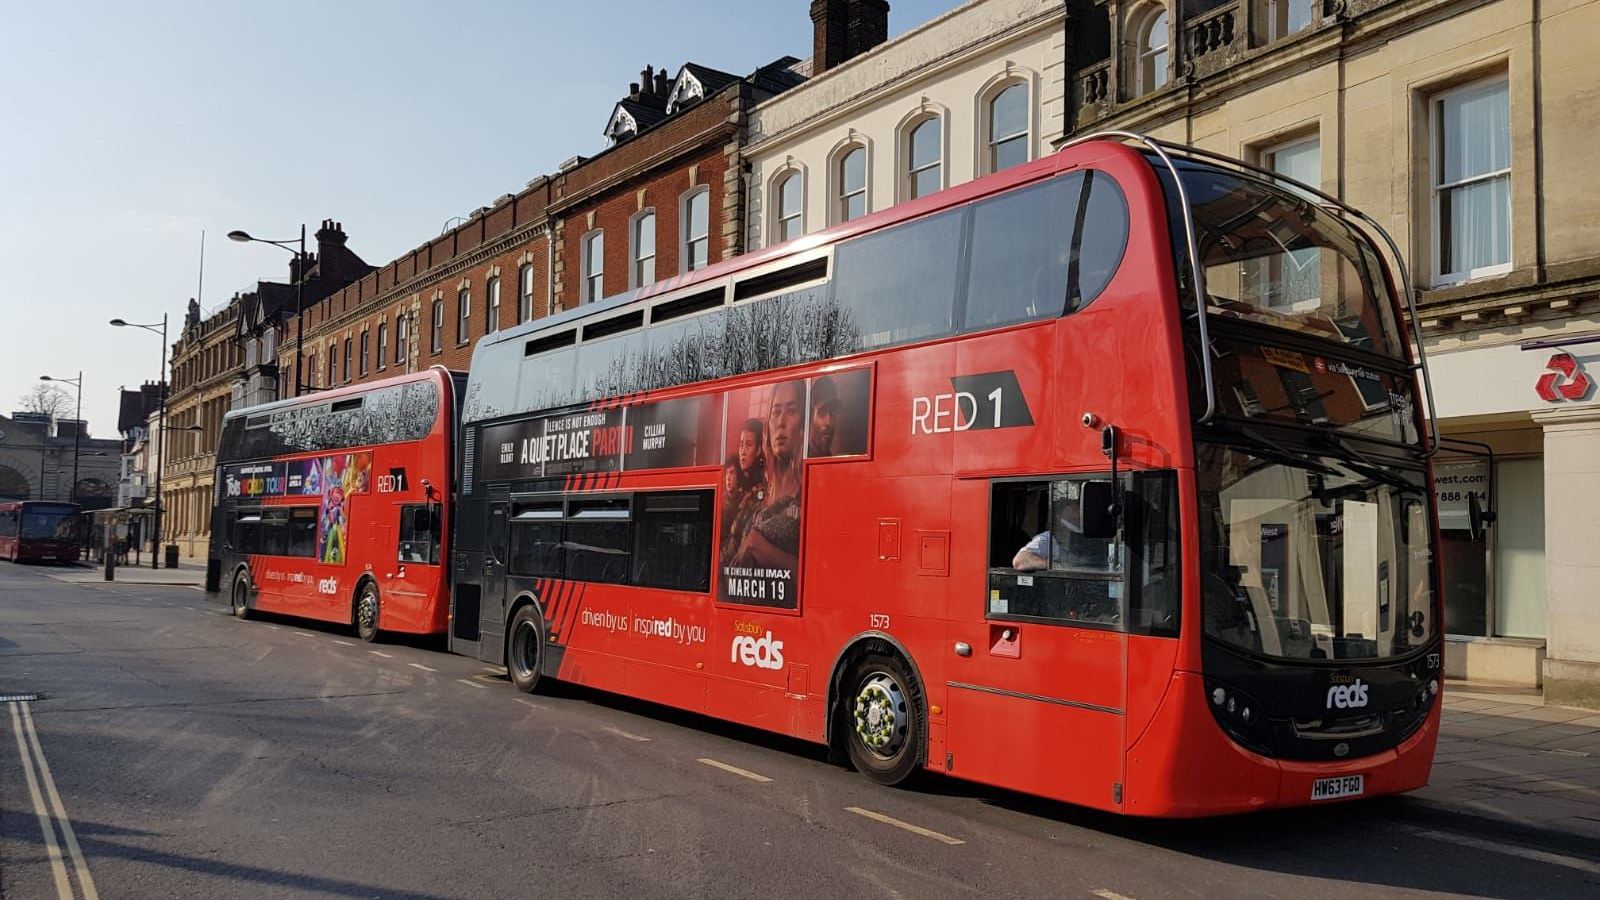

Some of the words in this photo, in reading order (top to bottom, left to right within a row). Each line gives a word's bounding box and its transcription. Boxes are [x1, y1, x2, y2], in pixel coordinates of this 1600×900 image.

[912, 391, 978, 435] RED
[988, 387, 1002, 428] 1
[565, 417, 571, 430] IS
[571, 415, 582, 429] NOT
[583, 413, 606, 427] ENOUGH
[644, 423, 666, 437] CILLIAN
[520, 438, 528, 465] A
[557, 429, 590, 461] PLACE
[642, 436, 666, 450] MURPHY
[377, 475, 396, 493] RED
[397, 474, 402, 492] 1
[1441, 491, 1461, 501] 888
[731, 567, 752, 577] CINEMAS
[754, 568, 765, 578] AND
[766, 569, 791, 580] IMAX
[319, 576, 337, 594] reds
[728, 578, 766, 599] MARCH
[771, 581, 785, 600] 19
[582, 607, 605, 627] driven
[606, 610, 617, 633] by
[617, 616, 628, 631] us
[634, 614, 672, 638] inspired
[673, 618, 685, 644] by
[687, 624, 706, 645] you
[734, 619, 764, 635] Salisbury
[870, 613, 890, 629] 1573
[731, 630, 784, 670] reds
[1327, 678, 1369, 709] reds
[1314, 778, 1340, 797] HW63
